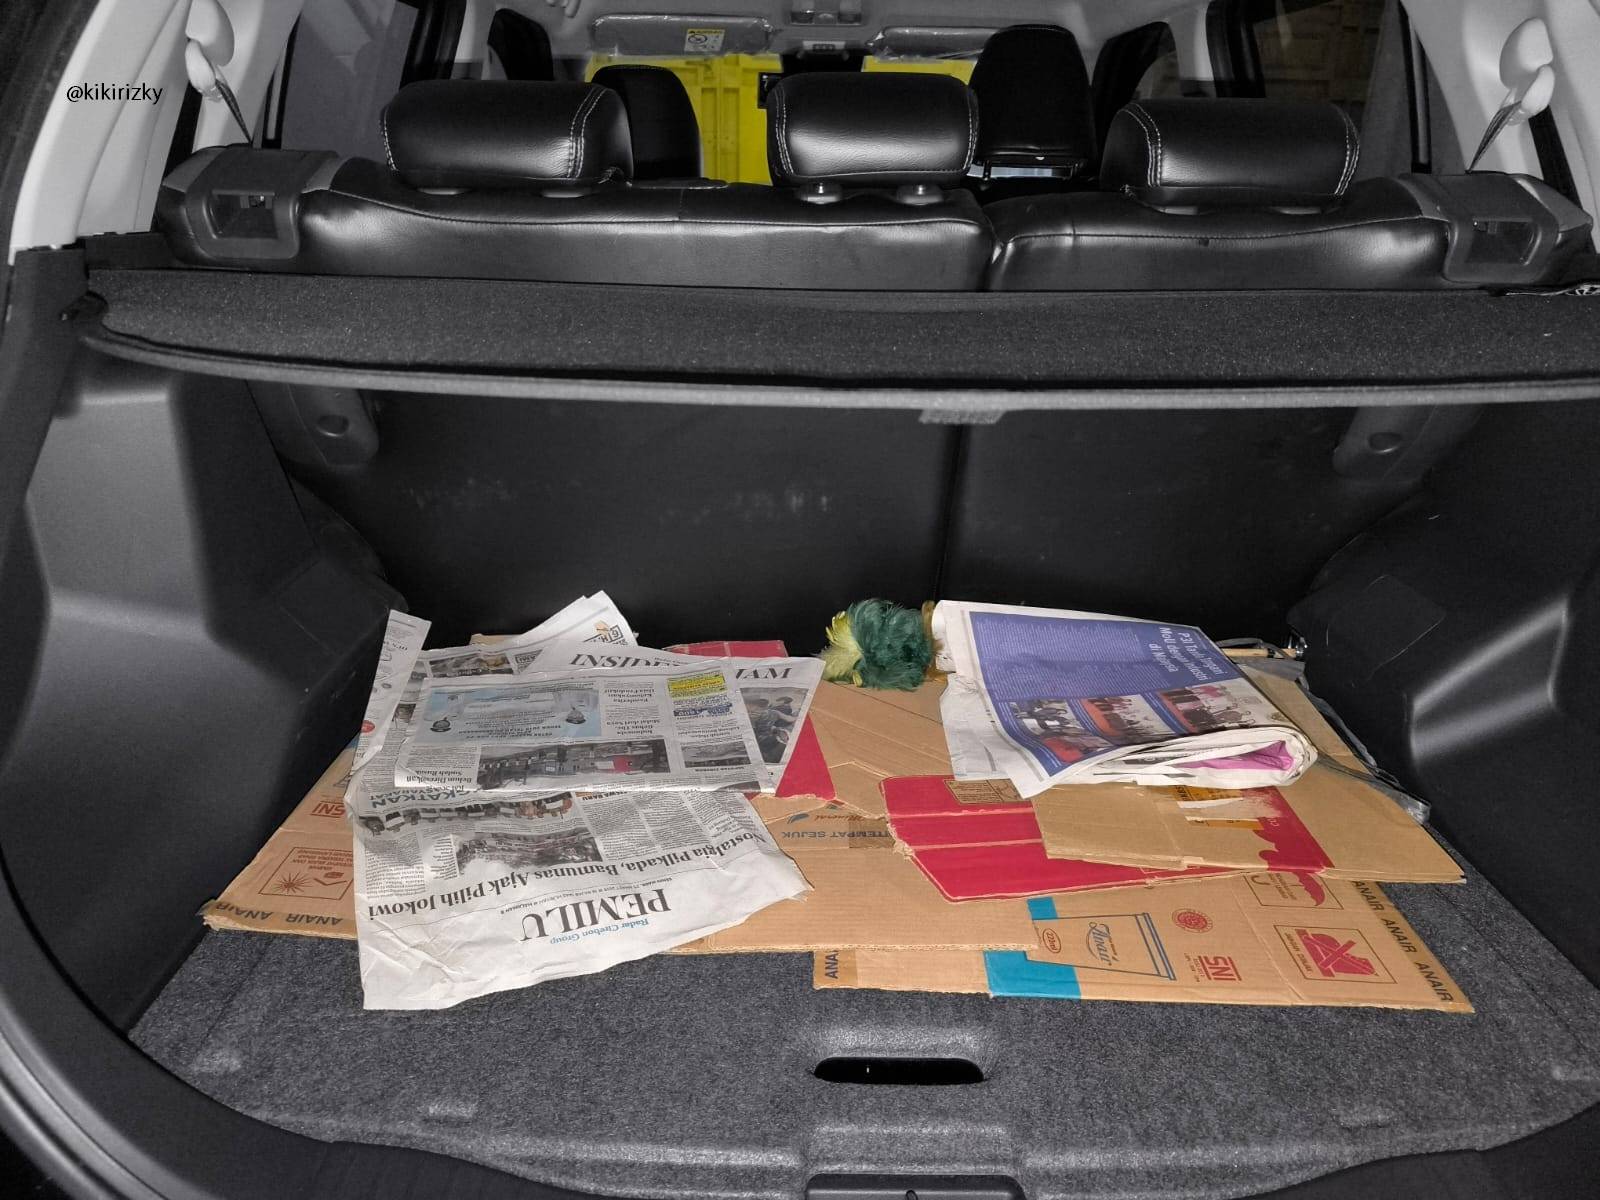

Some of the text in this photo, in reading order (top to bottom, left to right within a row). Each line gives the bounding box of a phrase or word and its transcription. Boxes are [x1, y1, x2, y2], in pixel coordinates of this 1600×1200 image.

[368, 831, 767, 921] Nostalgia Pilkada, Bamunas Ajak Pilih Jokowi
[215, 901, 276, 920] ANAIR
[1351, 881, 1385, 911] ANAIR
[285, 912, 344, 926] ANAIR
[520, 889, 672, 942] PEMILU
[550, 918, 649, 945] Radar Cirebon Group
[1381, 918, 1418, 953] ANAIR
[824, 949, 839, 980] ANA
[1203, 955, 1237, 981] SNI
[1414, 961, 1454, 1001] ANAIR
